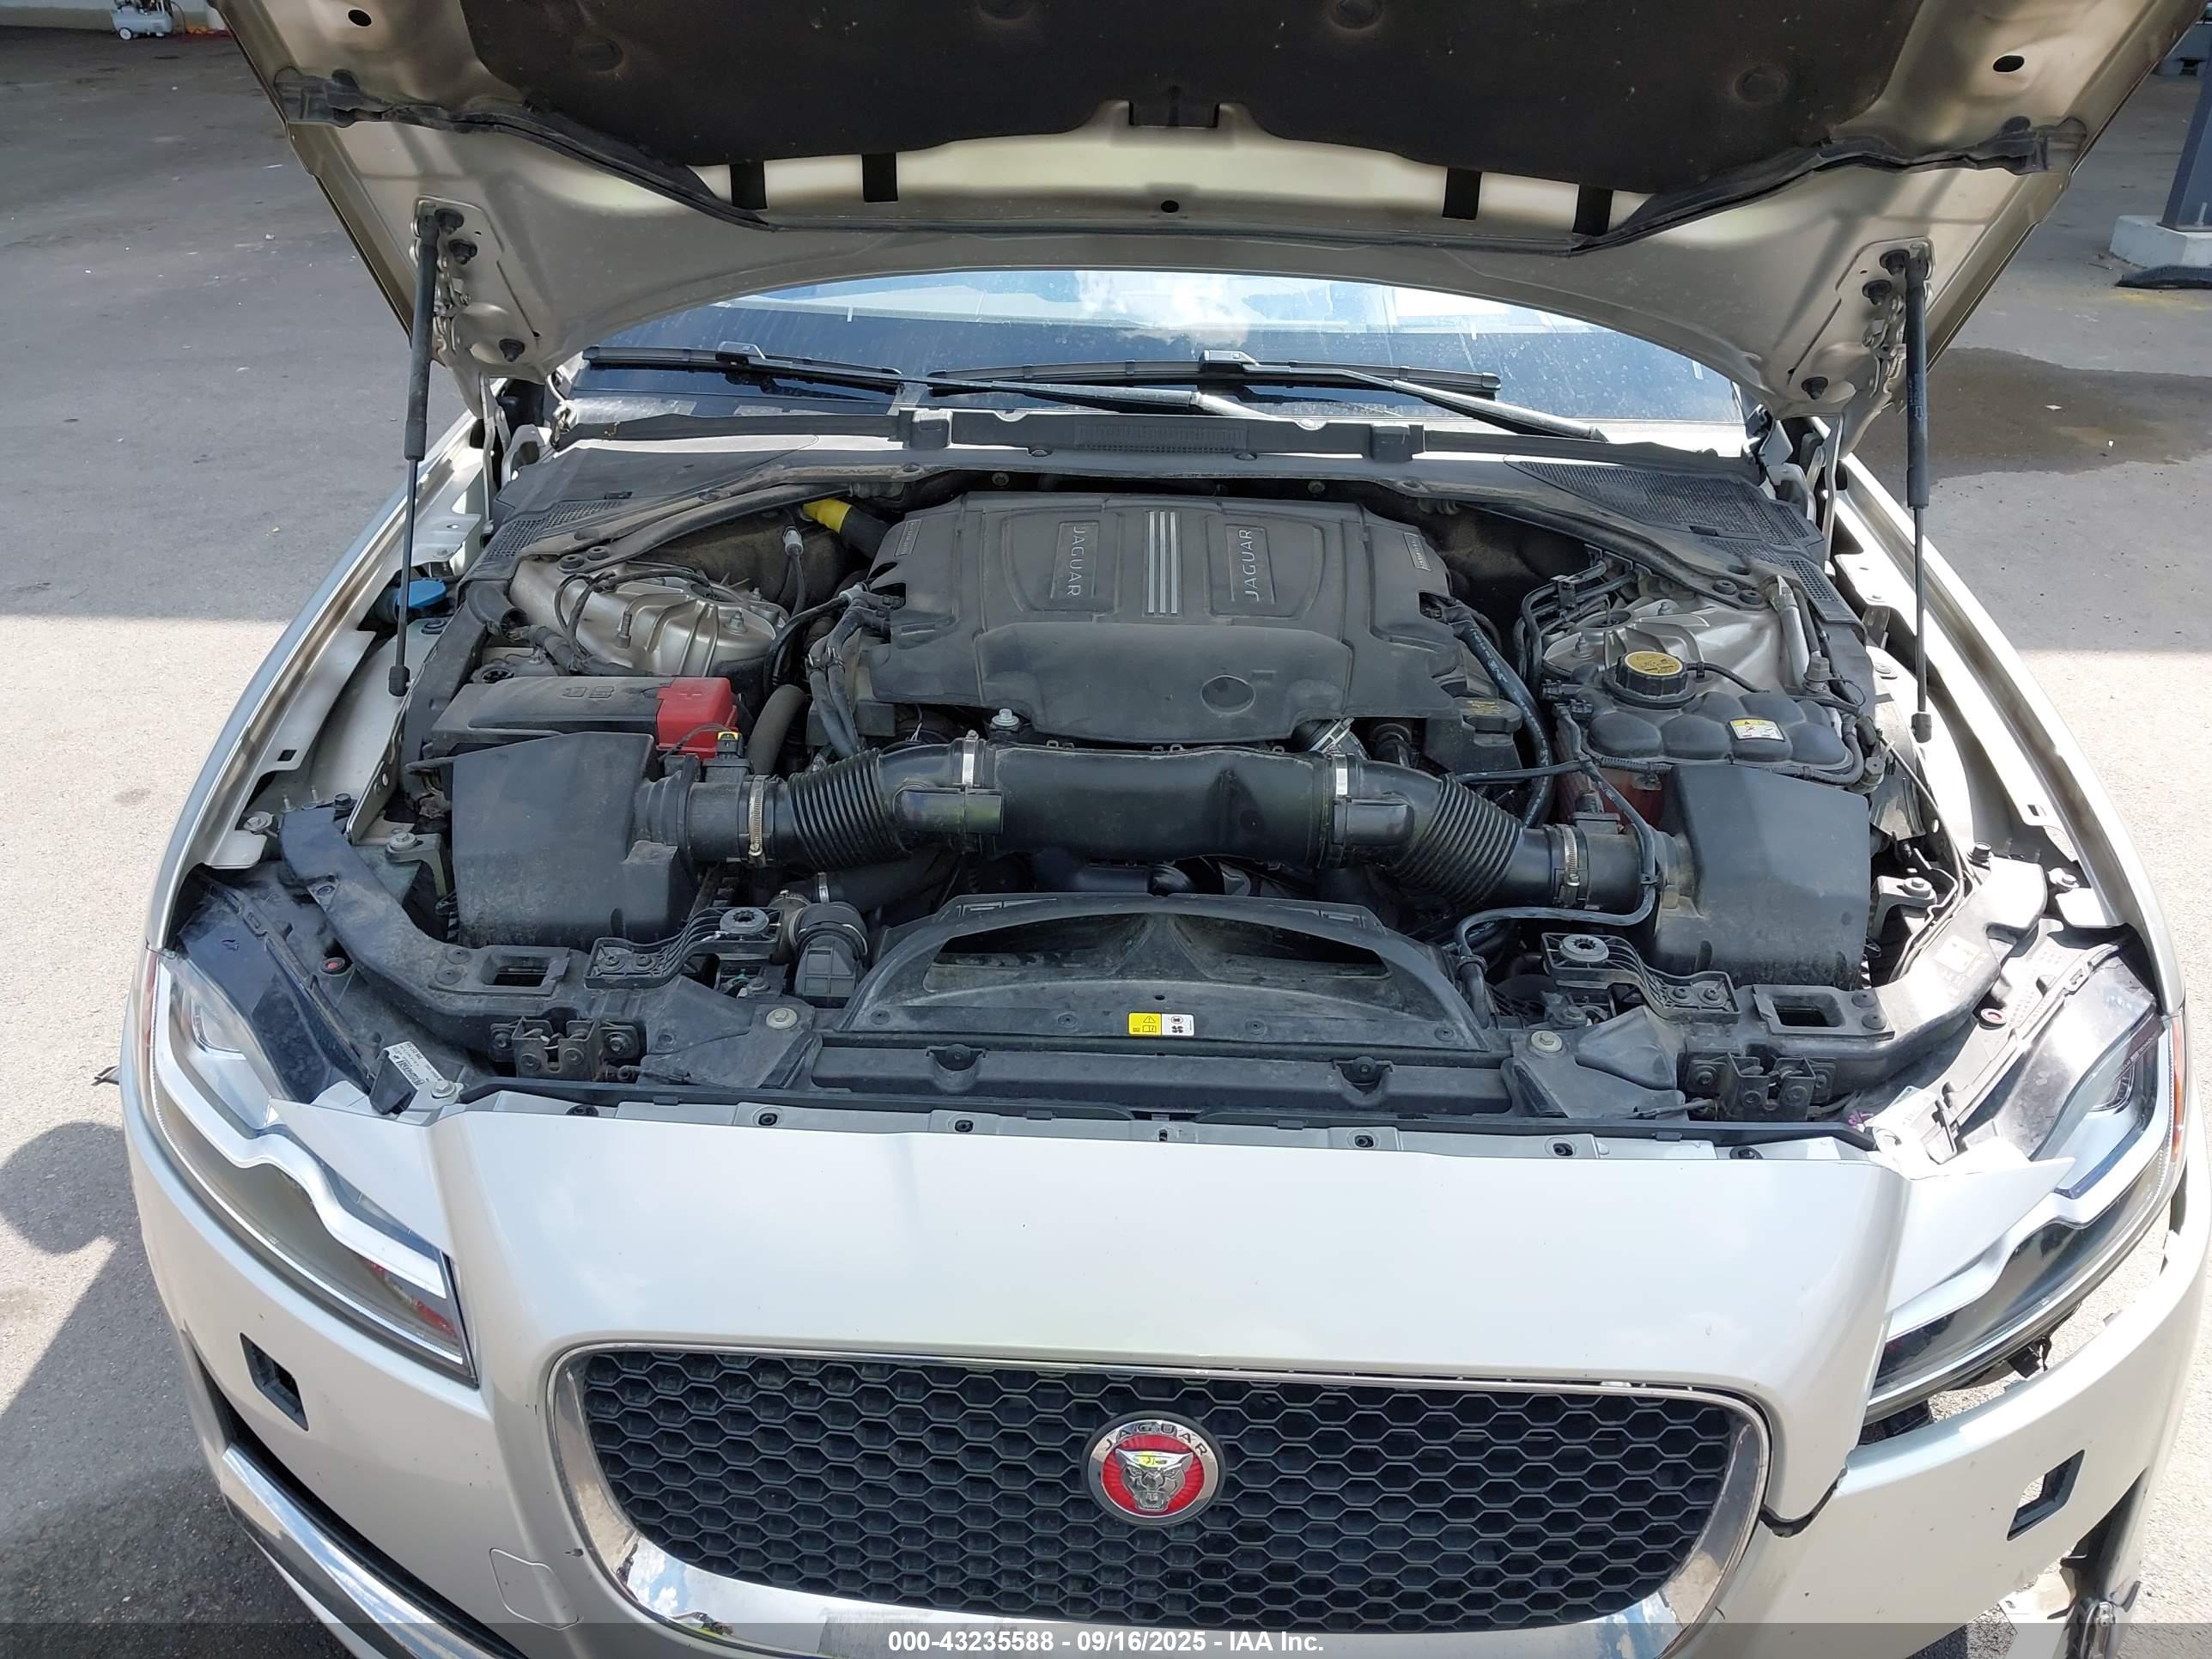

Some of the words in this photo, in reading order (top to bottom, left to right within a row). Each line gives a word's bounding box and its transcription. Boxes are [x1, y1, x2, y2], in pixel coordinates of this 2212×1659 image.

[1066, 526, 1086, 597] JAGUAR
[1238, 528, 1261, 602] JAGUAR
[1104, 1421, 1209, 1456] JAGUAR
